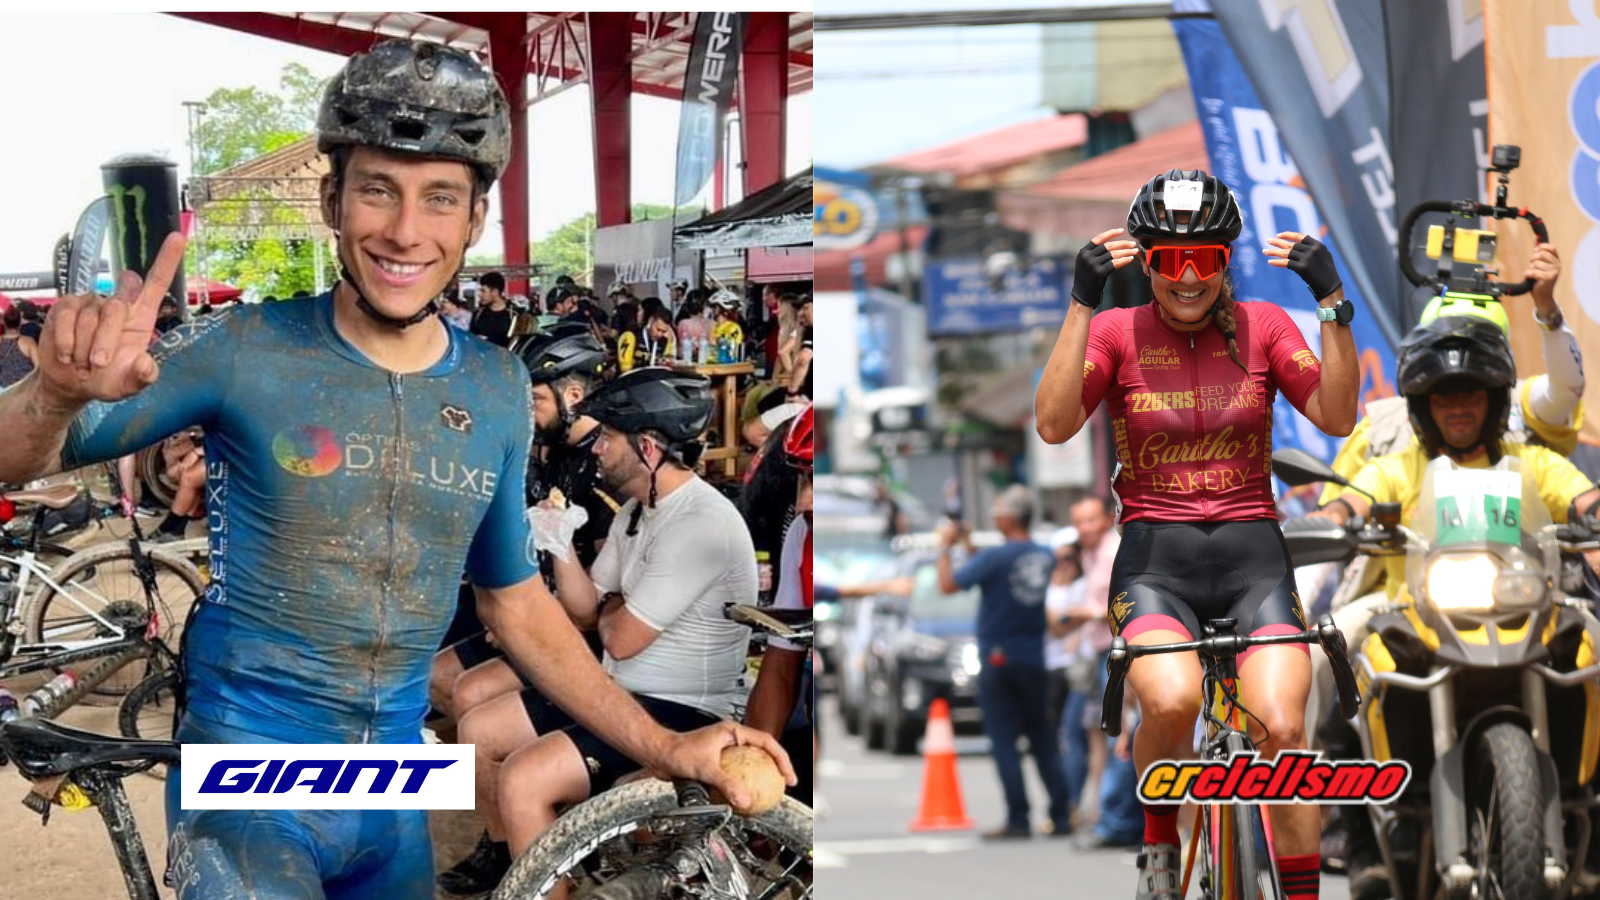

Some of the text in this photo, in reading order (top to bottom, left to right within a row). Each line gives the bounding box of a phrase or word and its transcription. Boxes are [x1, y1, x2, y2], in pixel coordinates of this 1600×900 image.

[1138, 356, 1180, 365] AGUILAR
[1212, 348, 1240, 357] TRAA
[1195, 380, 1257, 396] FEED YOUR
[1131, 391, 1196, 413] 226ERS
[1196, 393, 1259, 411] DREAMS
[1138, 425, 1260, 470] Caritho's
[1151, 467, 1250, 492] BAKERY
